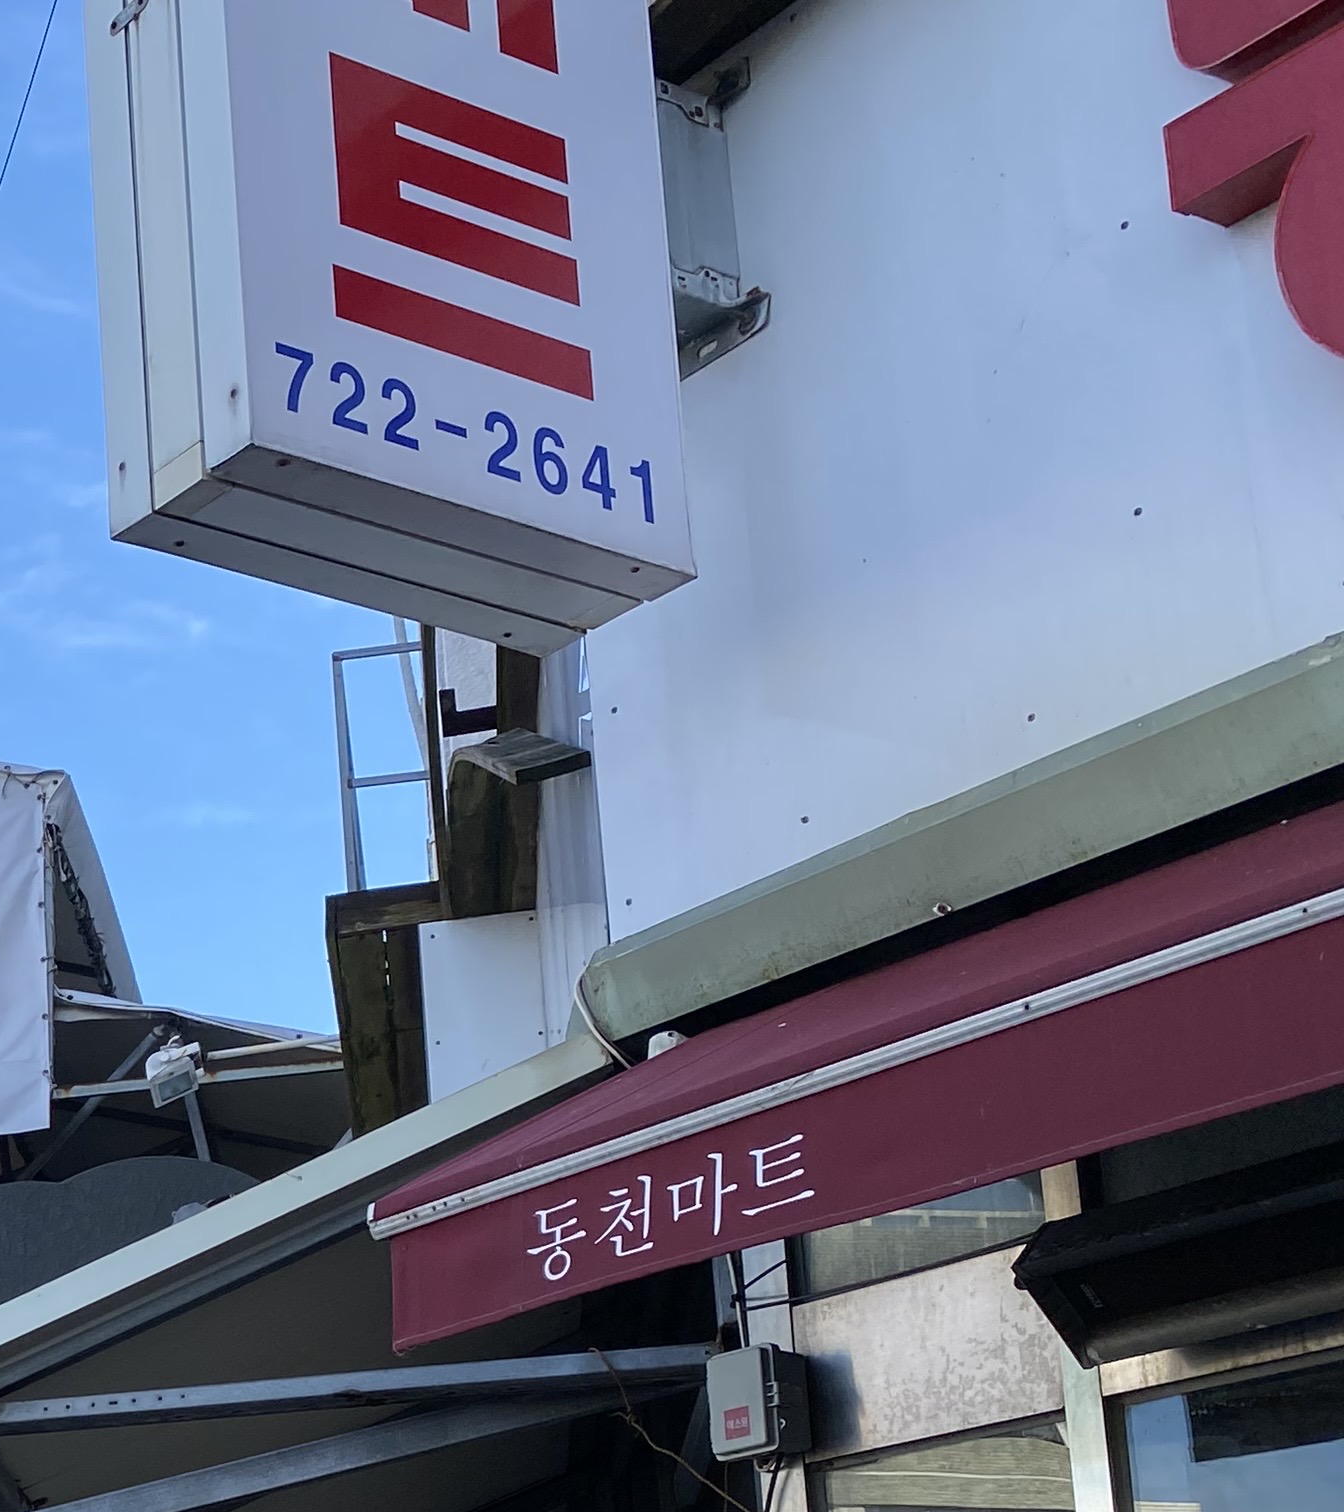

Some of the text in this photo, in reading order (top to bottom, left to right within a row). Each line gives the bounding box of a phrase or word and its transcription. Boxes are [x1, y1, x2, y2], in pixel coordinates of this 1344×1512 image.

[329, 0, 593, 400] 트
[274, 341, 657, 525] 722-2641
[525, 1133, 816, 1282] 동천마트
